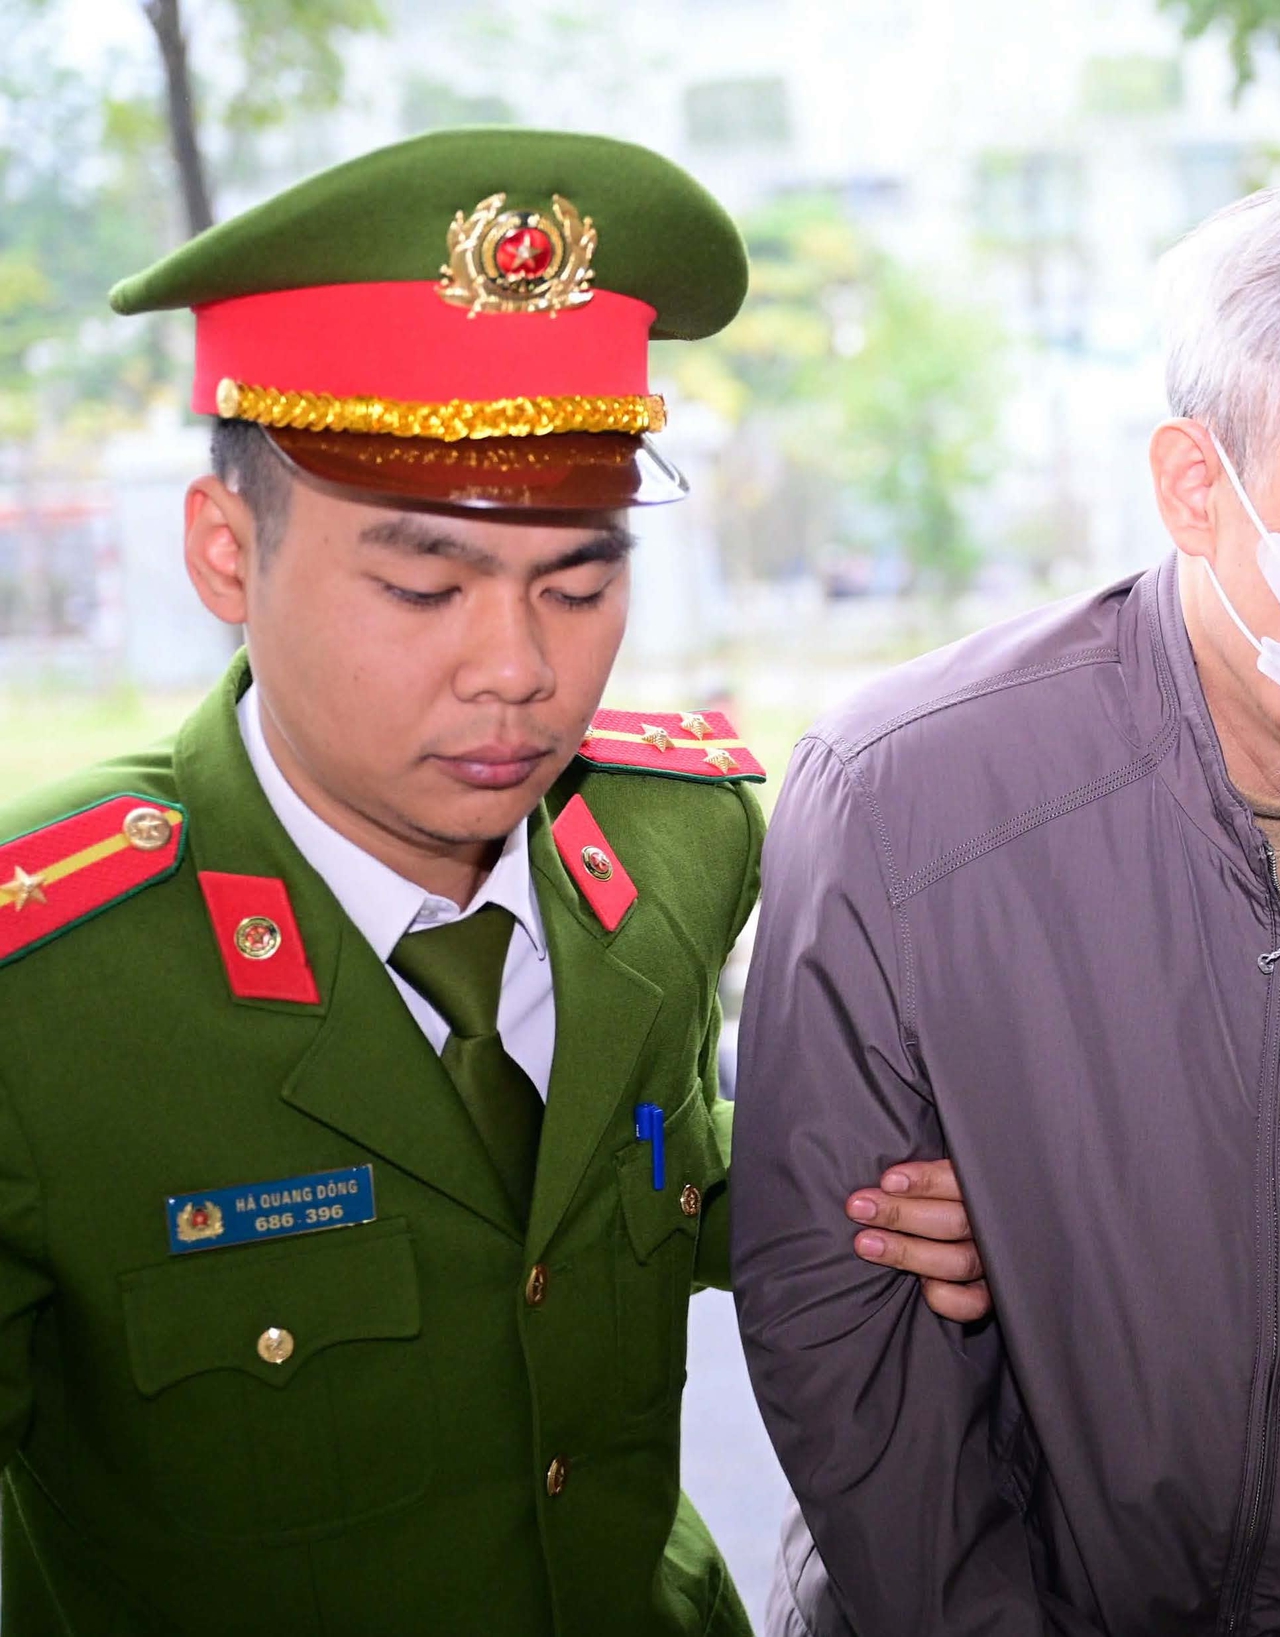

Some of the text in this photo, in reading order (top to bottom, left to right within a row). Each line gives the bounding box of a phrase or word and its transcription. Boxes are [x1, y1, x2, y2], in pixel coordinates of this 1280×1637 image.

[260, 1187, 313, 1208] QUANG
[255, 1212, 295, 1232] 686
[305, 1204, 344, 1224] 396
